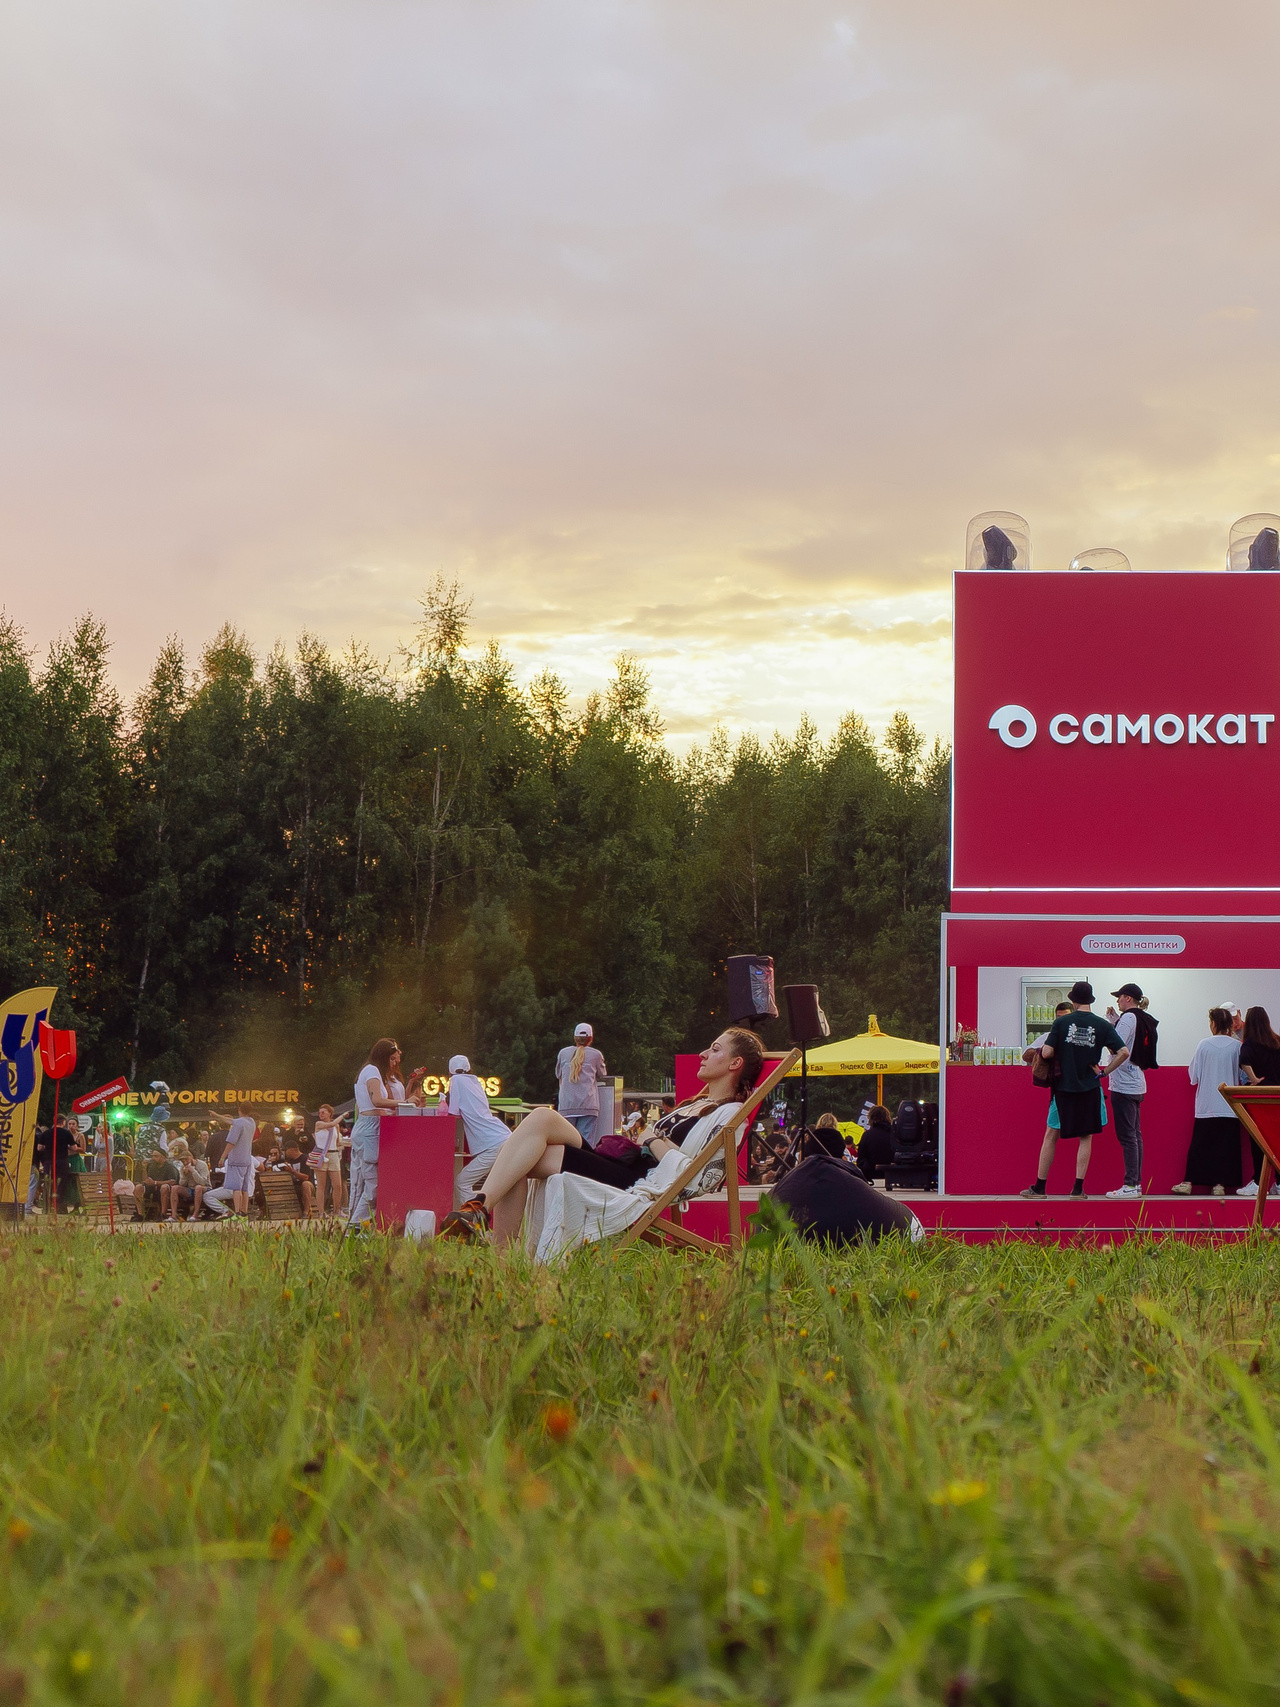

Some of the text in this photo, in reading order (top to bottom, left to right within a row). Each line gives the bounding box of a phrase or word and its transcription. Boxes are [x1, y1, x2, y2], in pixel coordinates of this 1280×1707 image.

[1049, 713, 1275, 745] самокат
[1088, 939, 1178, 949] Готовим напитки
[840, 1062, 888, 1071] Яндекс Еда
[905, 1061, 929, 1069] Яндекс
[422, 1075, 501, 1097] GYS
[112, 1089, 300, 1106] NEW YORK BURGER
